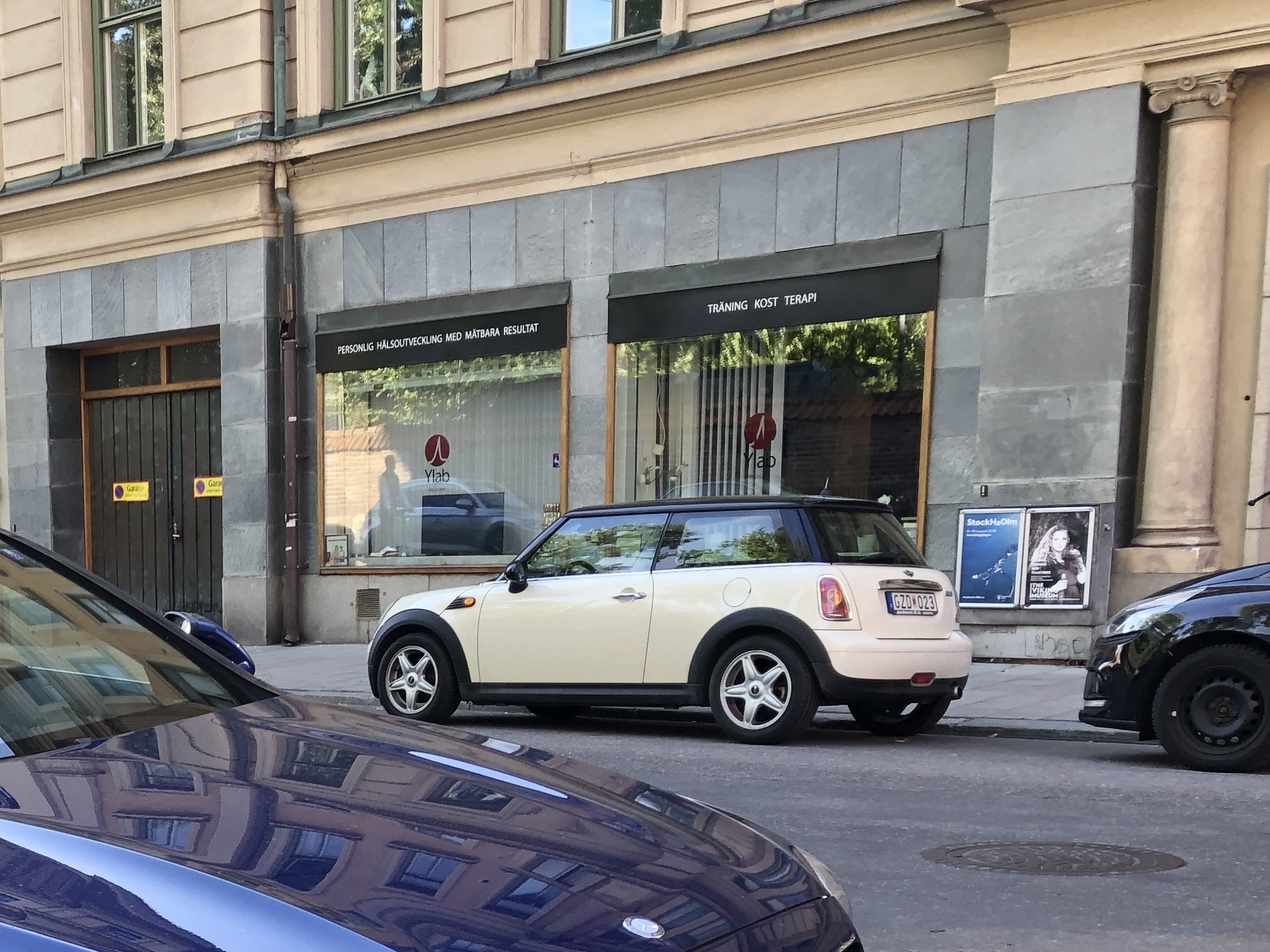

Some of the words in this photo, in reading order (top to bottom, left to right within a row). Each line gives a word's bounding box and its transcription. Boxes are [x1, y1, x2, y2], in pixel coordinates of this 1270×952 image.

[707, 300, 749, 314] TRÄNING
[754, 296, 779, 309] KOST
[784, 292, 817, 306] TERAPI
[337, 341, 374, 355] PERSONLIG
[376, 334, 443, 350] HÄLSOUTVECKLING
[445, 331, 462, 342] MED
[465, 328, 500, 340] MÄTBARA
[503, 322, 539, 336] RESULTAT
[424, 468, 450, 483] Ylab
[893, 594, 912, 609] GZD
[917, 595, 935, 610] 023
